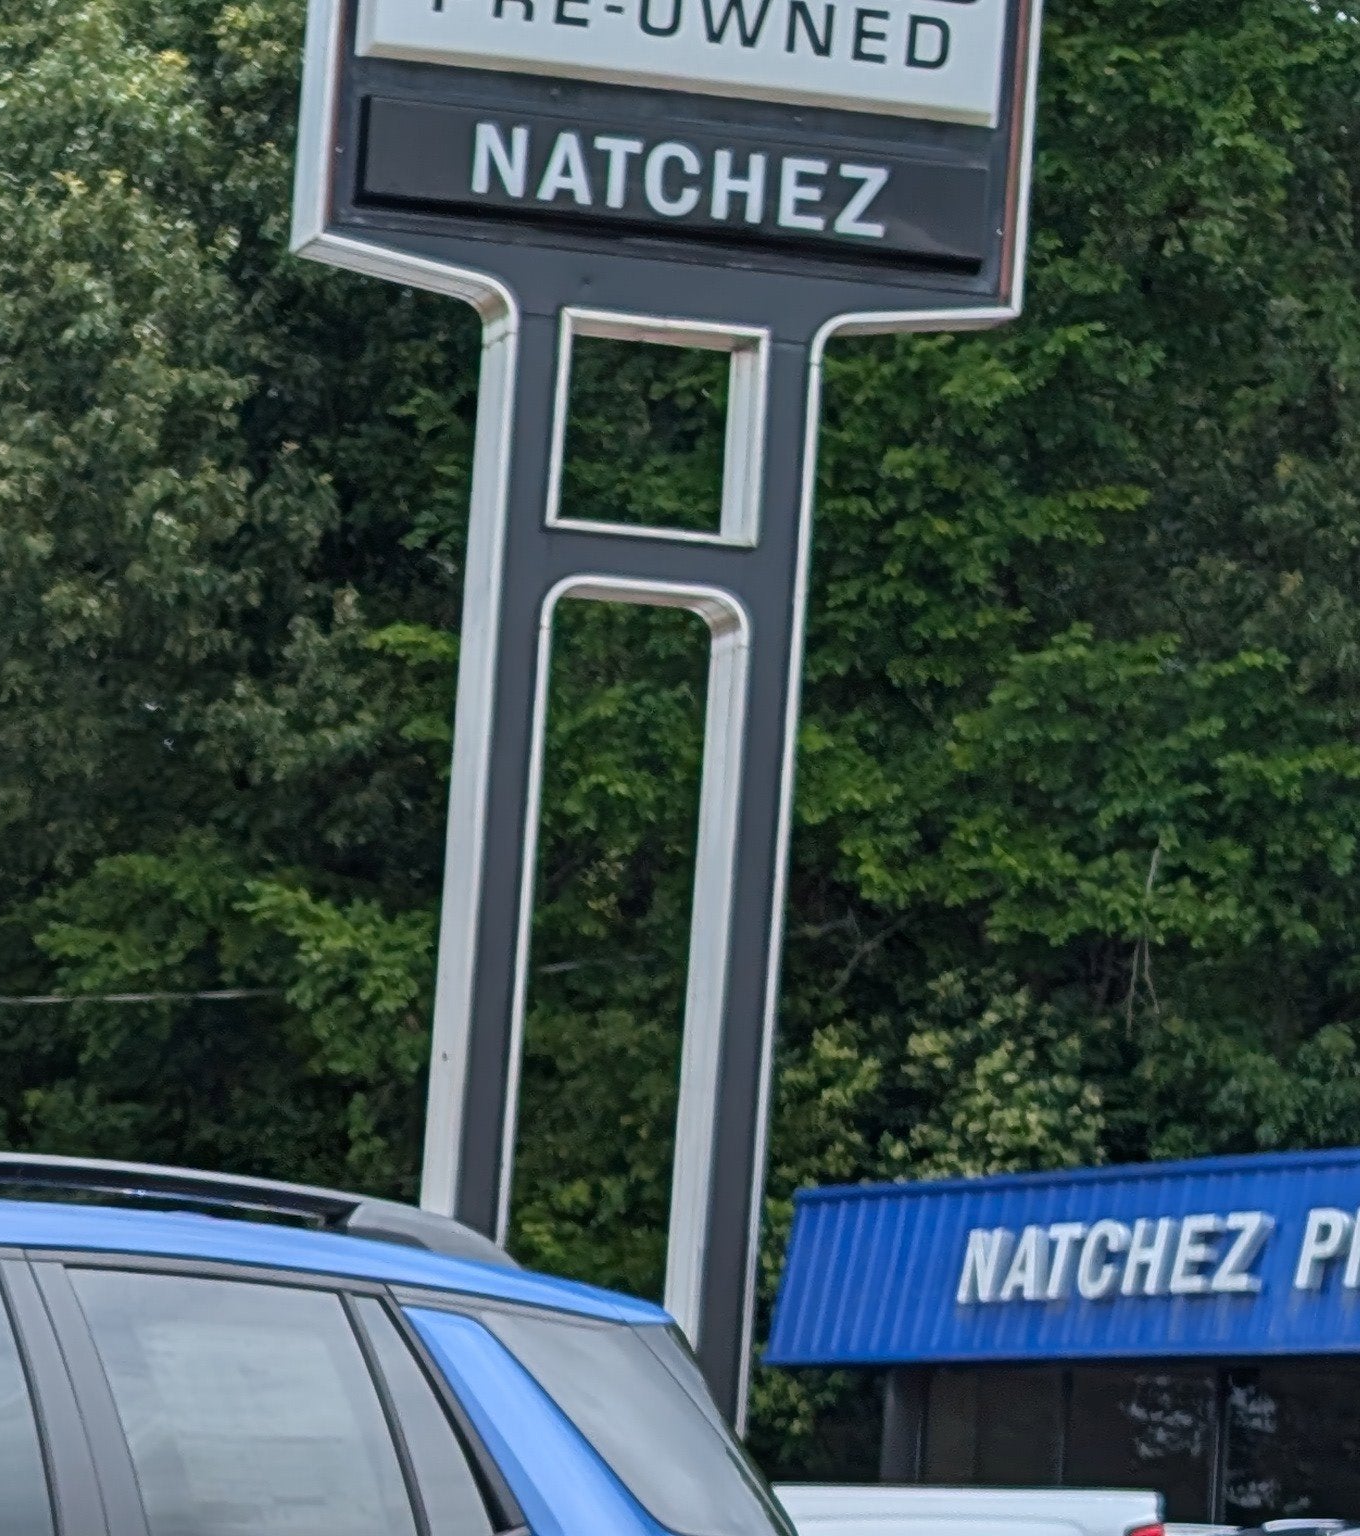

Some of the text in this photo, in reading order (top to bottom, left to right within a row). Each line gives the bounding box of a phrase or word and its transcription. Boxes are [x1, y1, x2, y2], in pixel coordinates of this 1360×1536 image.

[432, 0, 951, 70] E-OWNED
[470, 121, 893, 239] NATCHEZ
[956, 1210, 1276, 1304] NATCHEZ
